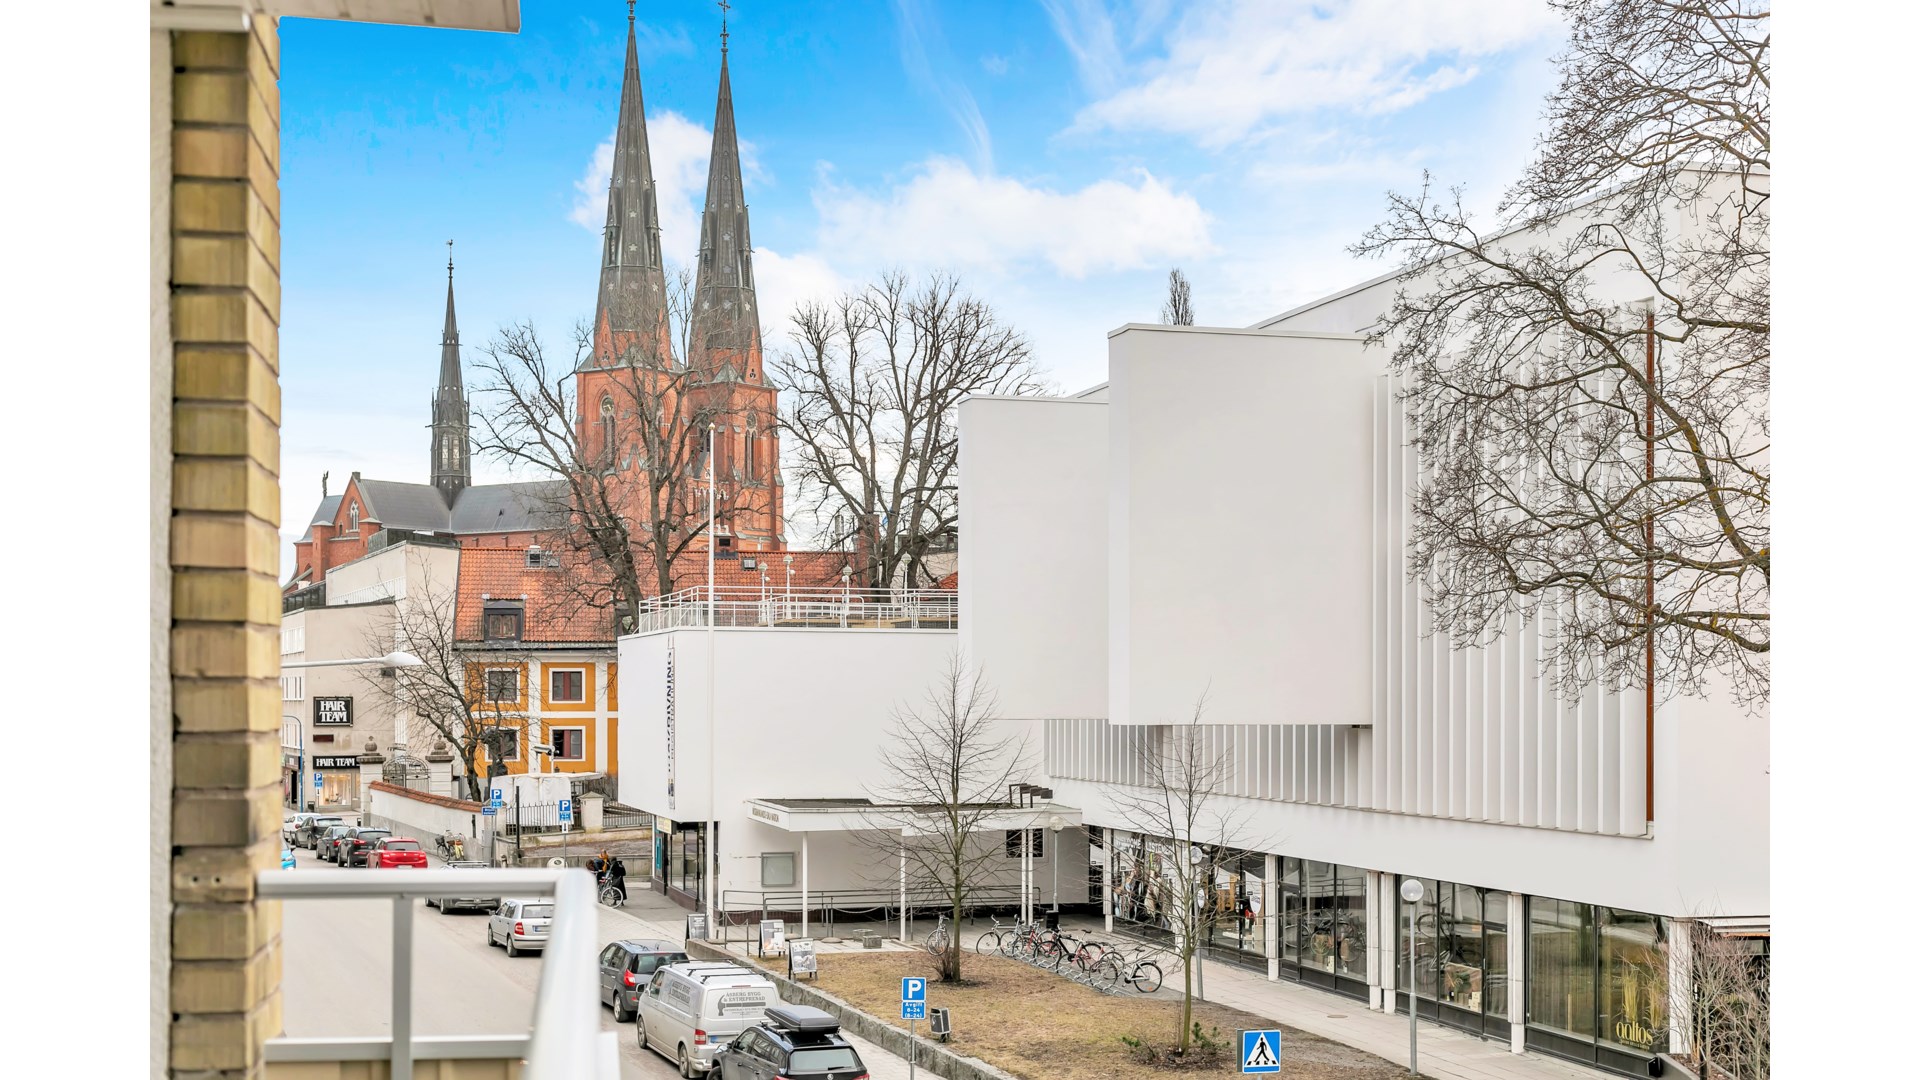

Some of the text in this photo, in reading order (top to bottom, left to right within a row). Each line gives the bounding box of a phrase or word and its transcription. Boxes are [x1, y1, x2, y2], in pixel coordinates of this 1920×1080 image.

[320, 700, 347, 711] HAIR
[318, 711, 348, 722] TEAM
[316, 758, 355, 767] HAIR TEAM
[493, 790, 500, 799] P
[562, 801, 569, 810] P
[908, 980, 922, 999] P
[1616, 1021, 1653, 1046] aaltos
